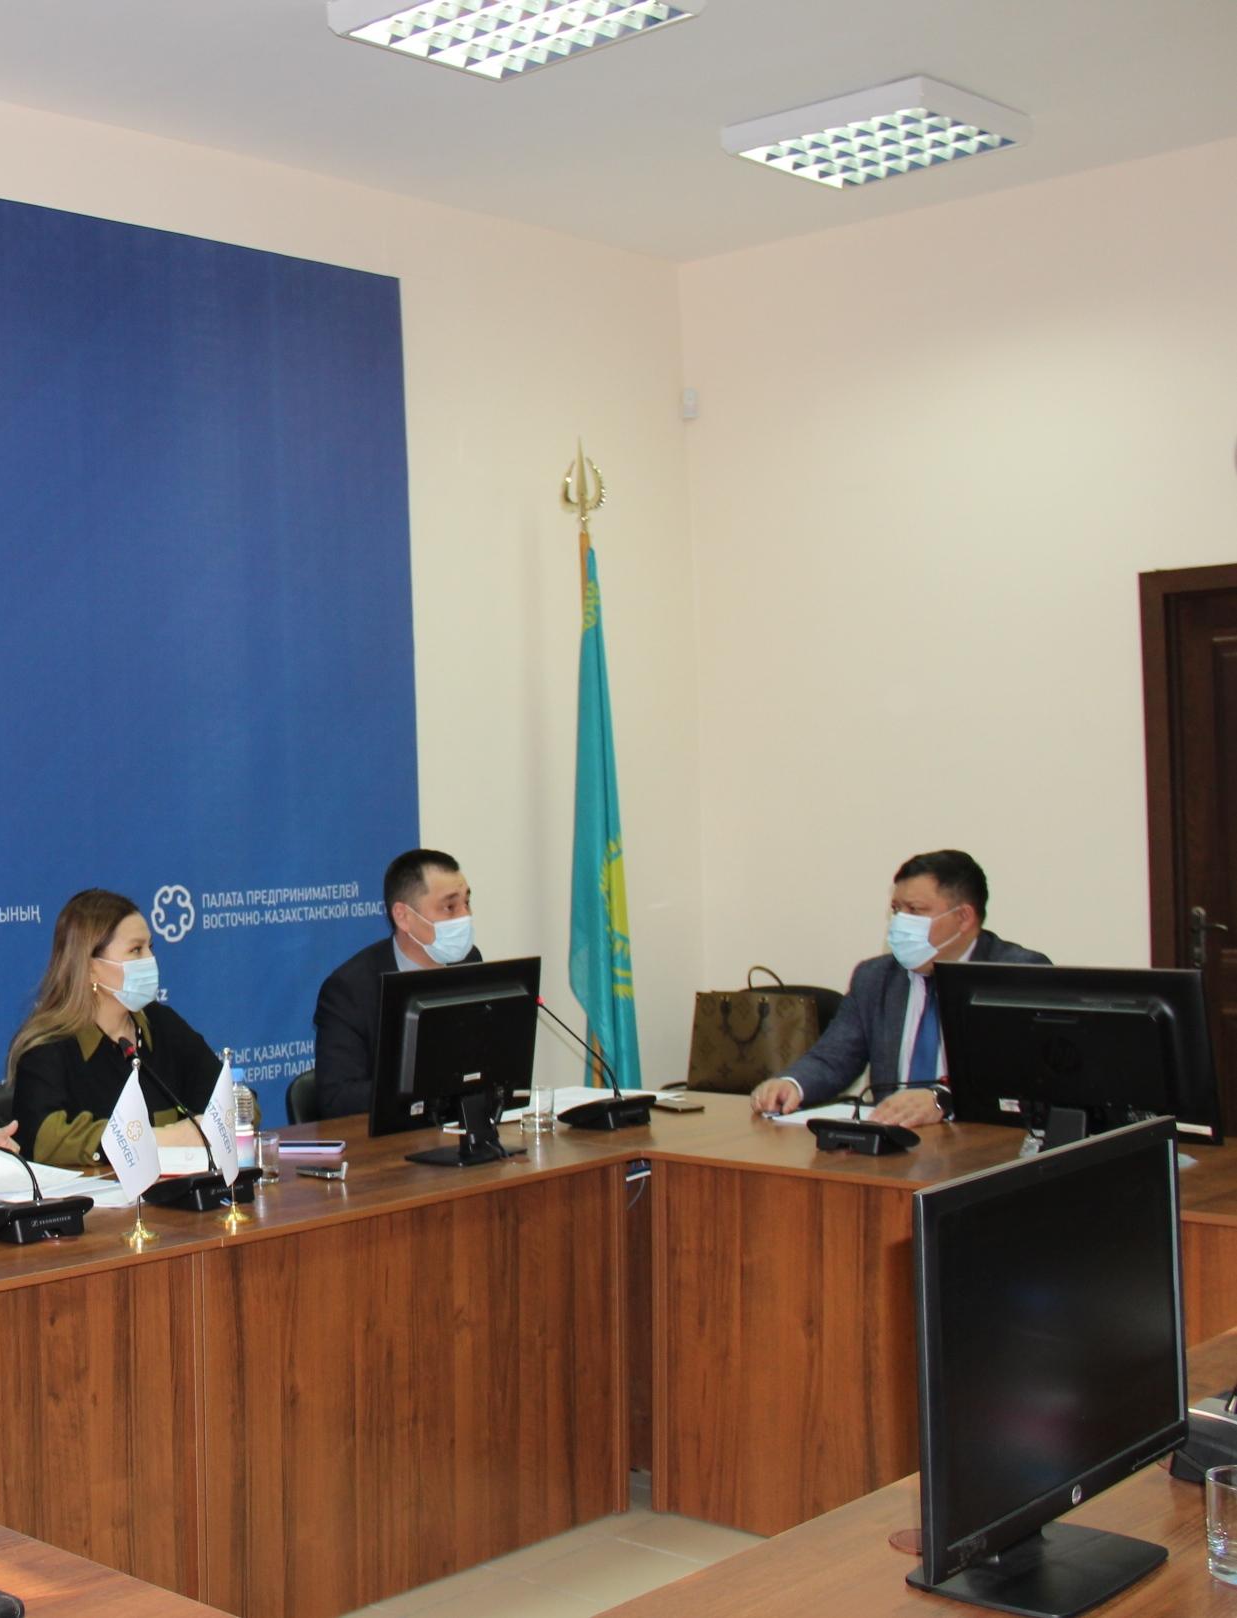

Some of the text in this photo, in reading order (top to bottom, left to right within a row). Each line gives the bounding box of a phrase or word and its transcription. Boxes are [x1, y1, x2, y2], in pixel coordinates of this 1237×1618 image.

[202, 881, 359, 909] ПАЛАТА ПРЕДПРИНИМАТЕЛЕЙ
[202, 901, 349, 929] ВОСТОЧНО-КАЗАХСТАНСКОЙ
